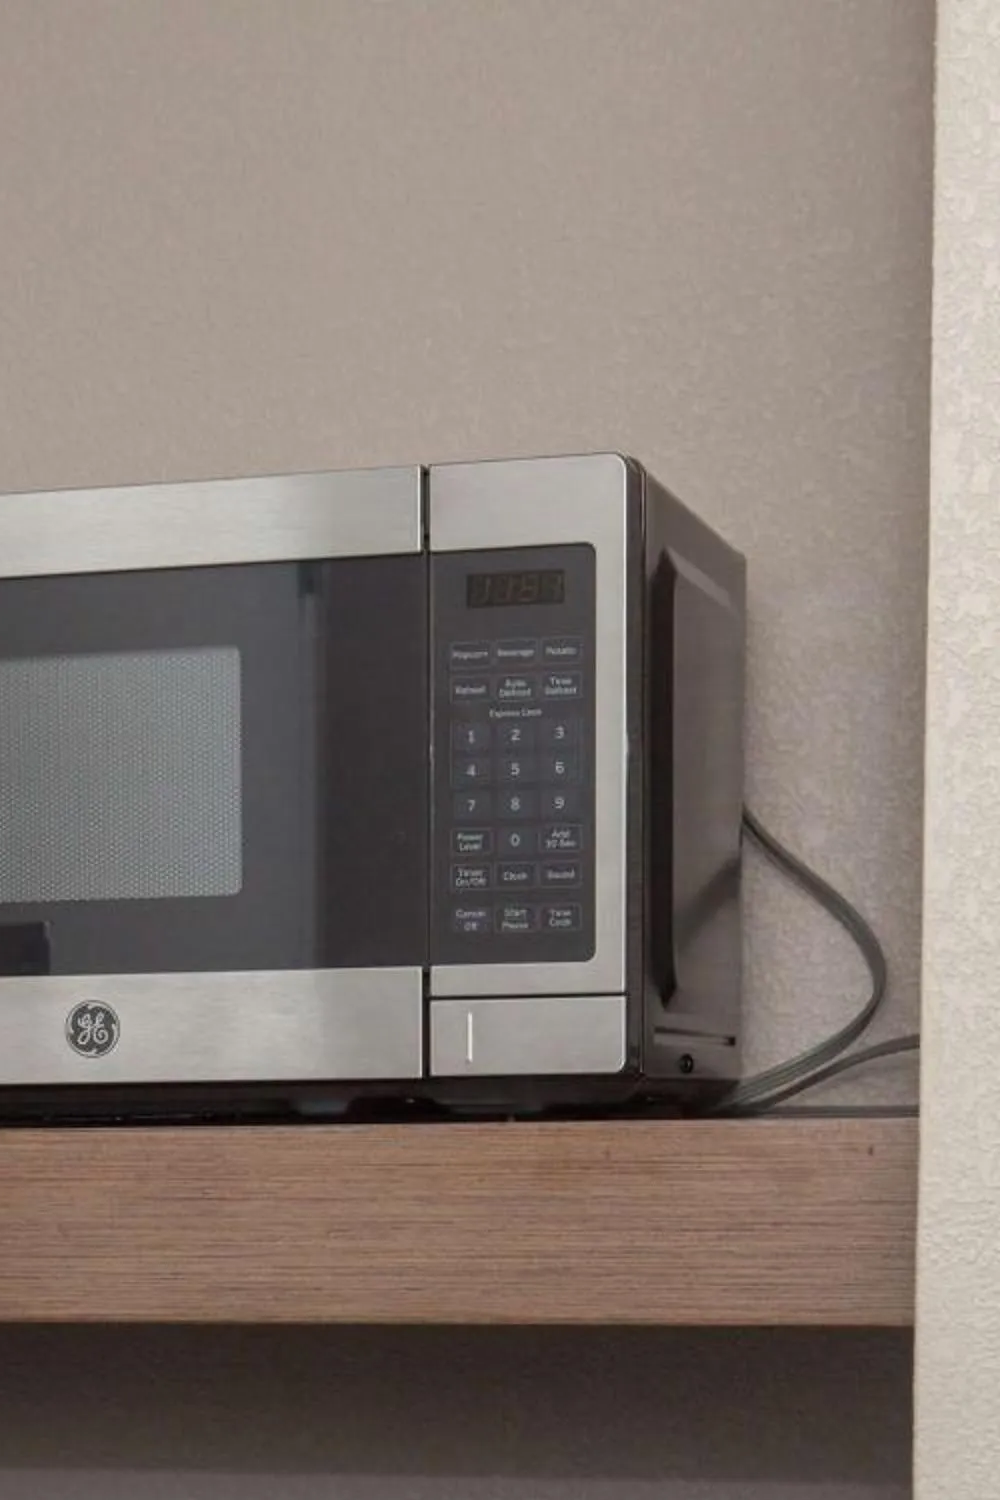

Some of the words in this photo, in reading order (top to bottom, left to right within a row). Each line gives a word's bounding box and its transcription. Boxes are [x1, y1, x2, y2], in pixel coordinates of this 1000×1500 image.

[467, 730, 475, 743] 1
[511, 729, 520, 741] 2
[555, 726, 565, 739] 3
[466, 764, 476, 777] 4
[511, 762, 520, 776] 5
[555, 761, 564, 774] 6
[467, 799, 476, 812] 7
[510, 797, 520, 811] 8
[554, 796, 565, 809] 9
[510, 833, 521, 847] 0
